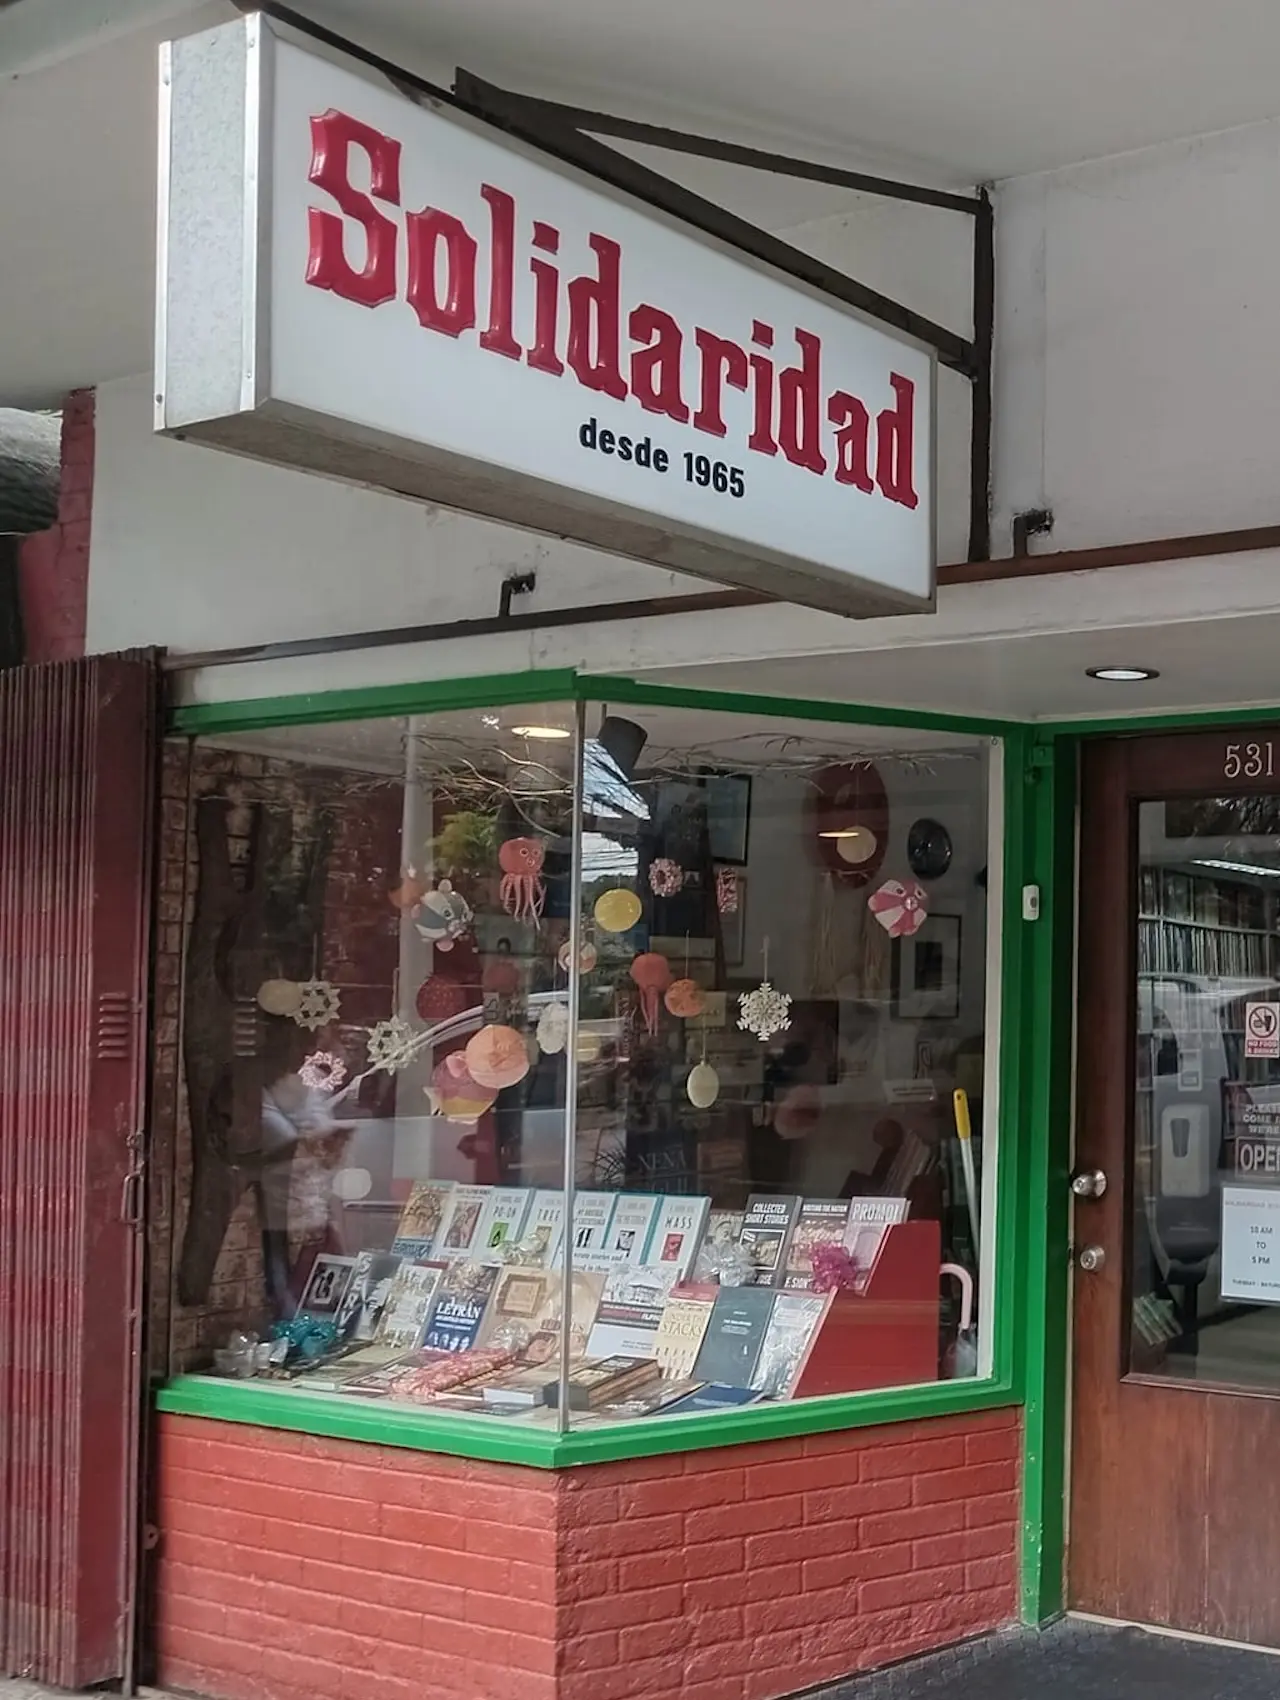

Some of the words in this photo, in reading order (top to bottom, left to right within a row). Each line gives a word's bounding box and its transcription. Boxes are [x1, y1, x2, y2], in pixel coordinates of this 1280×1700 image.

[305, 108, 918, 509] Solidaridad
[579, 417, 669, 473] desde
[683, 452, 745, 498] 1965
[1224, 742, 1273, 778] 531
[1242, 1113, 1272, 1124] COME
[752, 1203, 787, 1214] COLLECTED
[665, 1216, 694, 1229] MASS
[744, 1213, 763, 1224] SHORT
[763, 1214, 790, 1225] STORIES
[1260, 1226, 1273, 1234] AM
[1256, 1240, 1267, 1249] TO
[1258, 1256, 1270, 1265] PM
